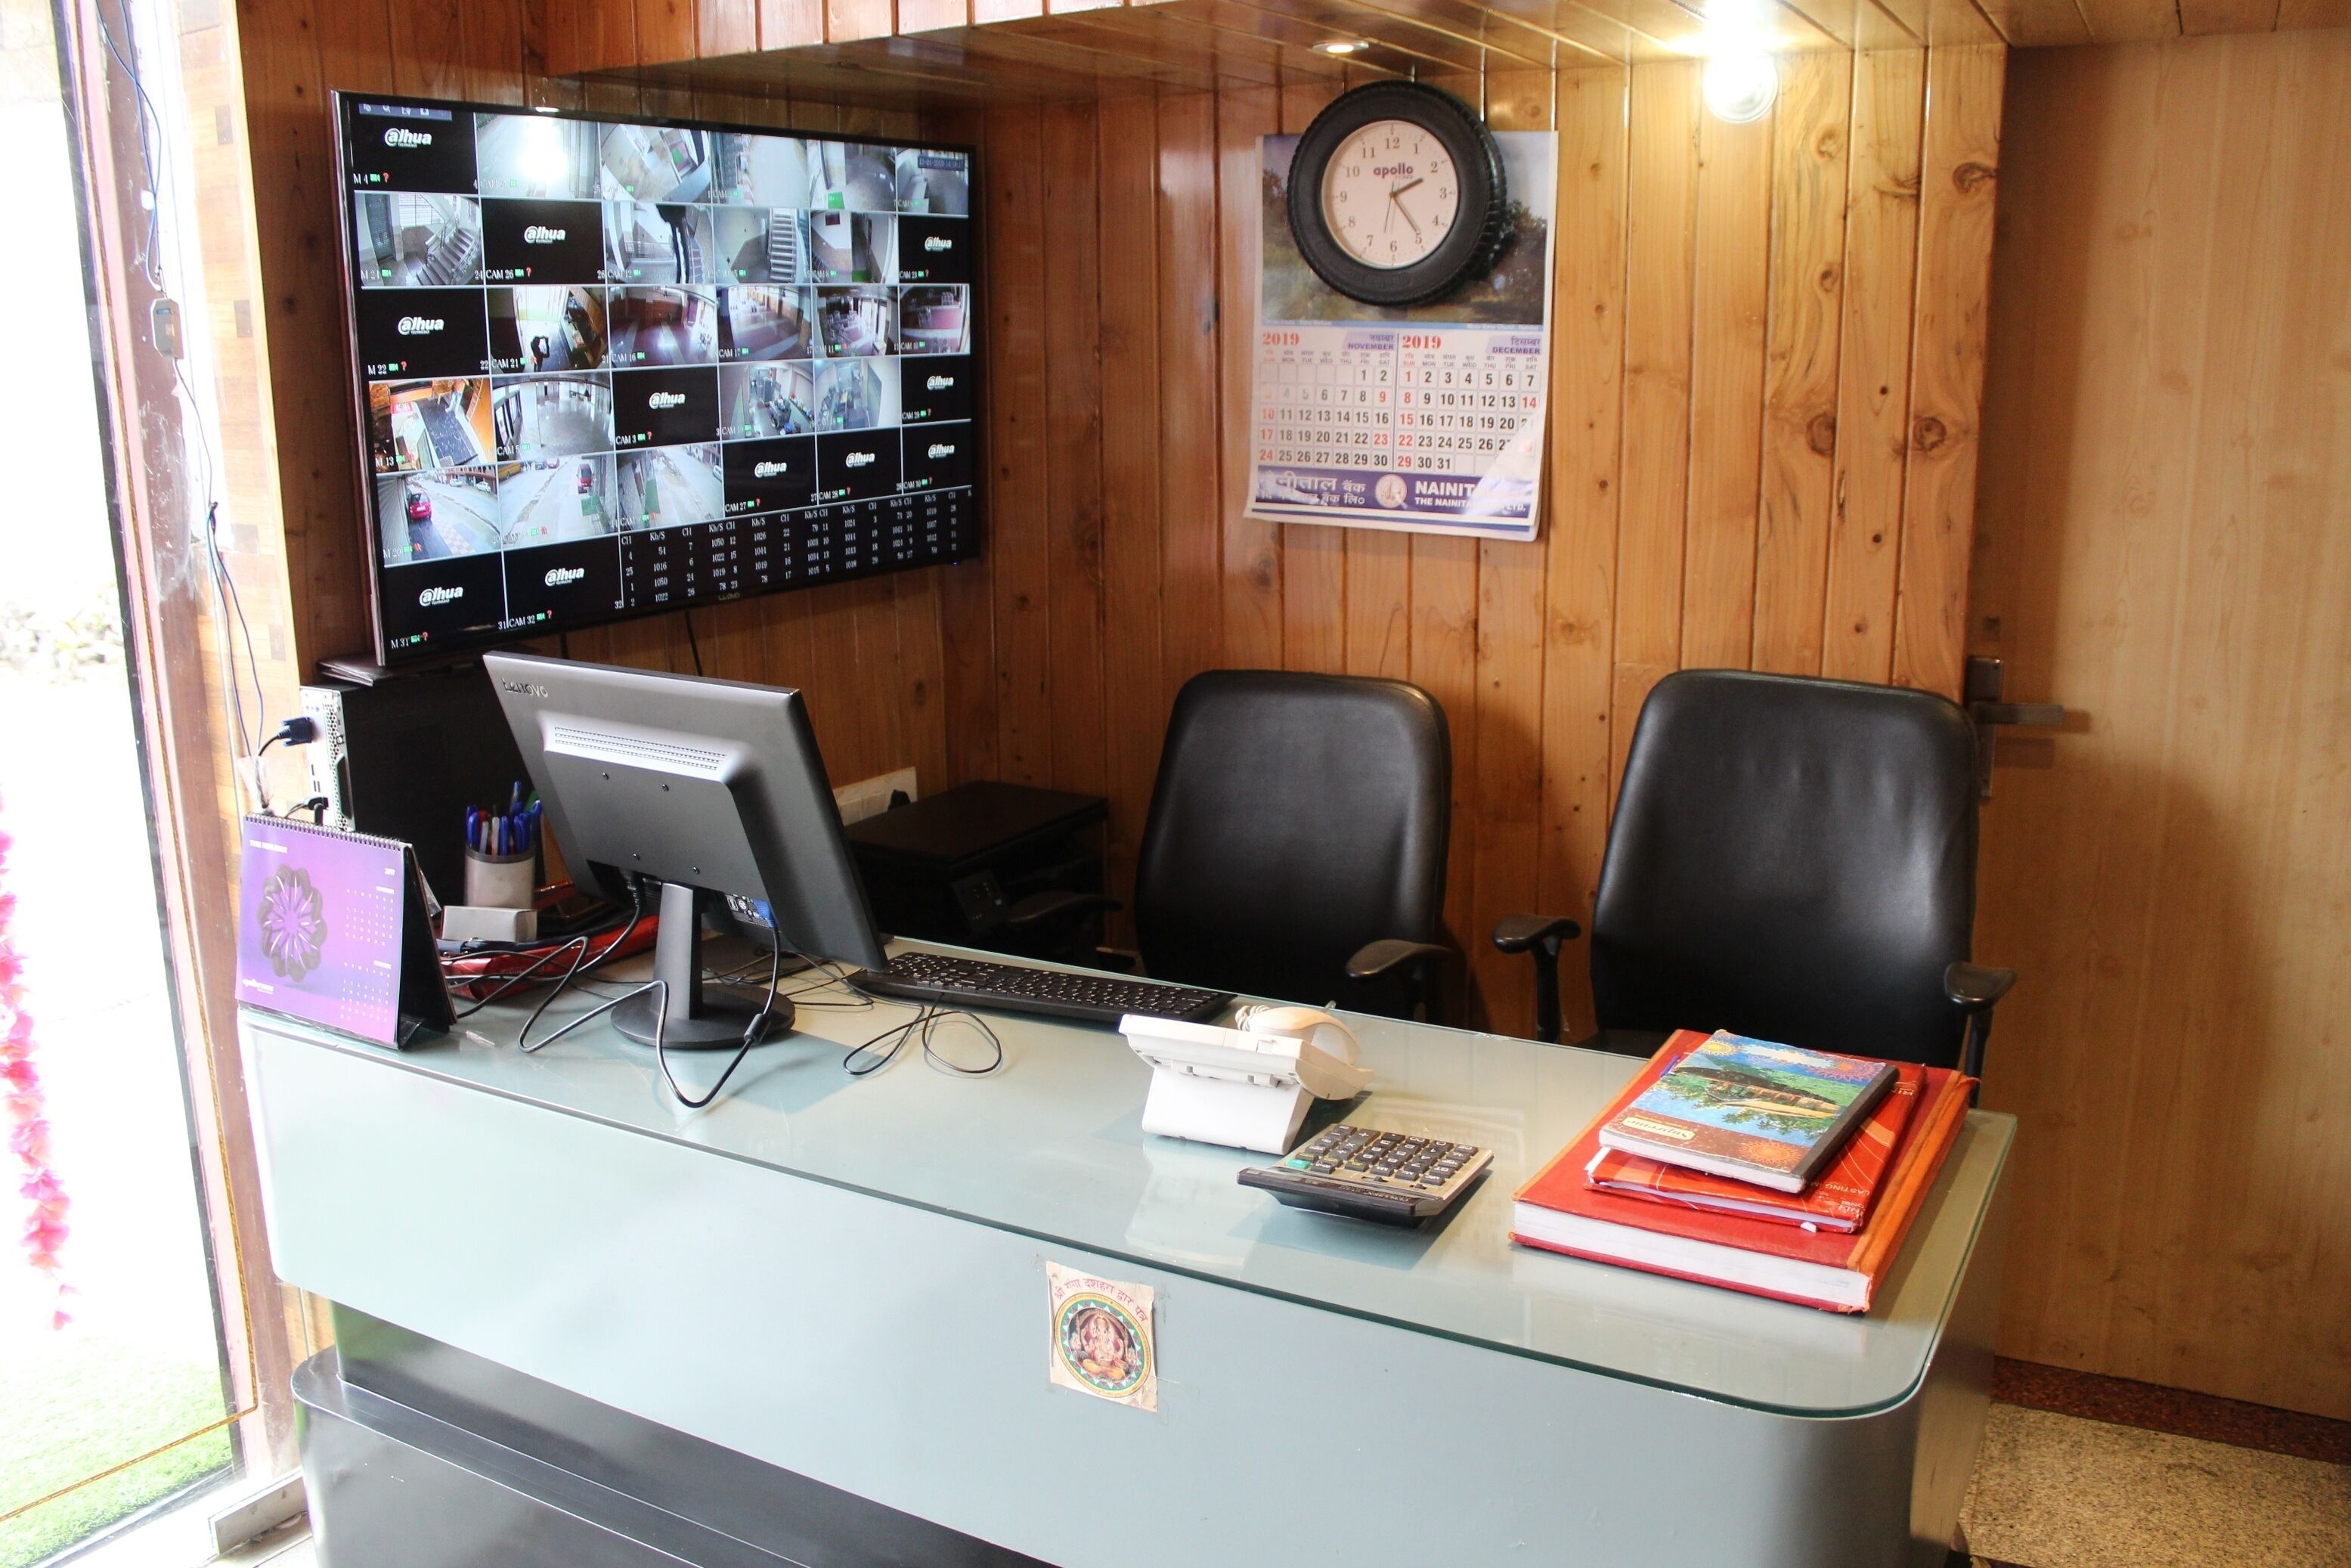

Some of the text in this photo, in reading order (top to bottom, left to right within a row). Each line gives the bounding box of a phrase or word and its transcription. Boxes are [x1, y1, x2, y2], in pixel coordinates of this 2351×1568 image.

[1385, 138, 1399, 149] 12
[1414, 144, 1418, 154] 1
[1362, 147, 1375, 158] 11
[1346, 166, 1359, 177] 10
[1374, 163, 1414, 178] apollo
[1431, 162, 1438, 173] 2
[1340, 191, 1347, 202] 9
[1440, 187, 1447, 199] 3
[1349, 216, 1356, 227] 8
[1432, 215, 1439, 226] 4
[1367, 235, 1374, 246] 7
[1415, 231, 1422, 243] 5
[1390, 241, 1397, 252] 6
[486, 269, 513, 280] CAM 26
[1263, 333, 1299, 345] 2019
[1403, 336, 1442, 349] 2019
[719, 349, 741, 357] CAM 17
[378, 364, 387, 374] 22
[480, 361, 488, 370] 22
[492, 358, 518, 369] CAM 21
[1361, 370, 1387, 381] 1 2
[1406, 371, 1534, 386] 1 2 3 4 5 6 7
[1302, 390, 1386, 402] 5 6 7 8 9
[1405, 392, 1536, 408] 8 9 10 11 12 13 14
[1262, 408, 1389, 423] 10 11 12 13 14 15 16
[1401, 414, 1414, 425] 15
[1420, 414, 1433, 426] 16
[1440, 415, 1453, 426] 17
[1460, 417, 1473, 427] 18
[1480, 417, 1494, 428] 19
[1500, 418, 1514, 429] 20
[616, 434, 637, 445] CAM 3
[1261, 429, 1388, 445] 17 18 19 20 21 22 23
[1399, 435, 1493, 450] 22 23 24 25 26
[1260, 449, 1387, 466] 24 25 26 27 28 29 30
[1399, 456, 1450, 469] 29 30 31
[1342, 479, 1366, 493] बैंक
[725, 502, 746, 513] CAM 27
[1436, 499, 1473, 507] NAINITA
[689, 542, 692, 550] 7
[720, 582, 726, 590] 78
[510, 615, 534, 628] CAM 32
[502, 677, 548, 698] Lenovo
[1826, 1184, 1869, 1196] LASTING
[1055, 1286, 1064, 1300] श्री
[1135, 1305, 1148, 1322] पत्र
